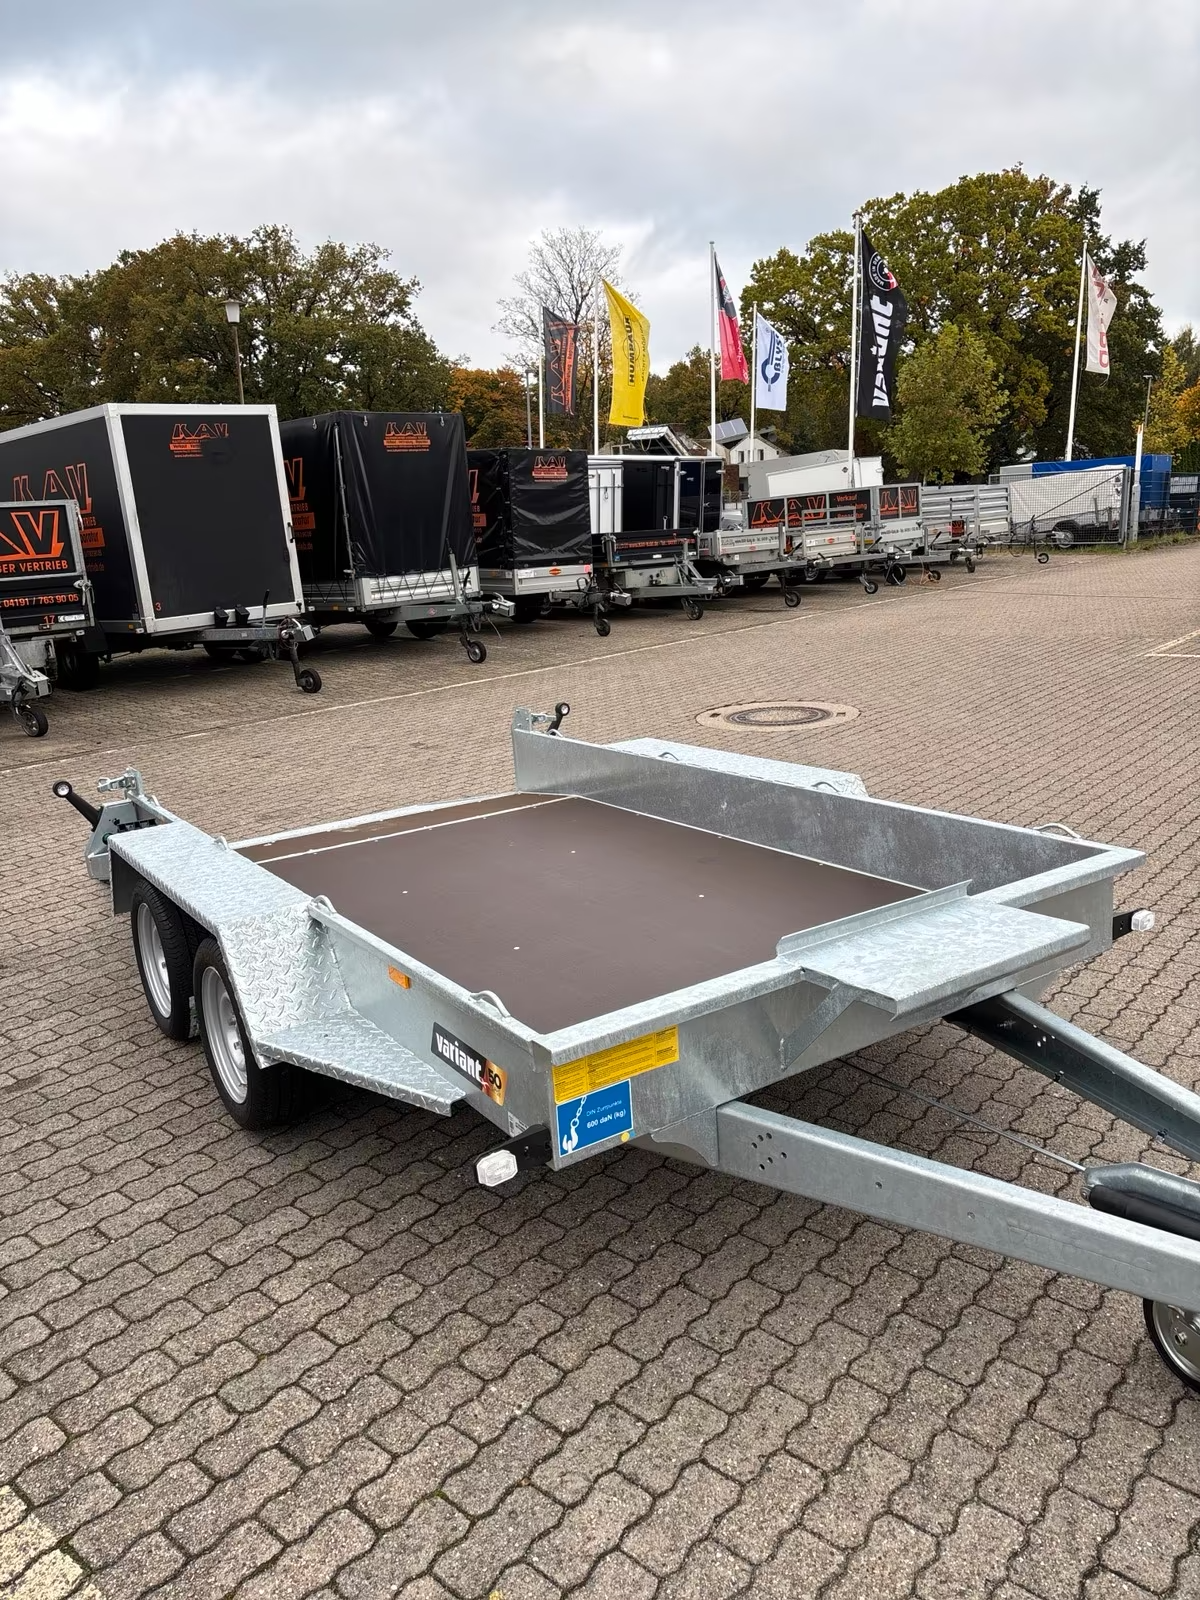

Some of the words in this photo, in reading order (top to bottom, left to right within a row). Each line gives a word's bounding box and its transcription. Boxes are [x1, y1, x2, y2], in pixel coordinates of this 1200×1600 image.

[872, 273, 885, 286] MADE
[172, 422, 229, 440] KAV
[385, 421, 428, 437] KAV
[533, 455, 566, 469] KAV
[880, 489, 917, 512] KAV
[751, 495, 826, 525] KAV
[19, 560, 69, 572] VERTRIEB
[3, 597, 30, 608] 04191
[38, 595, 54, 605] 763
[56, 594, 67, 603] 90
[69, 593, 79, 602] 05
[155, 603, 162, 611] 3
[44, 615, 56, 624] 17
[435, 1032, 482, 1082] variant
[488, 1067, 502, 1090] 50
[586, 1119, 599, 1129] 600
[599, 1113, 613, 1124] daN
[613, 1108, 627, 1120] (kg)
